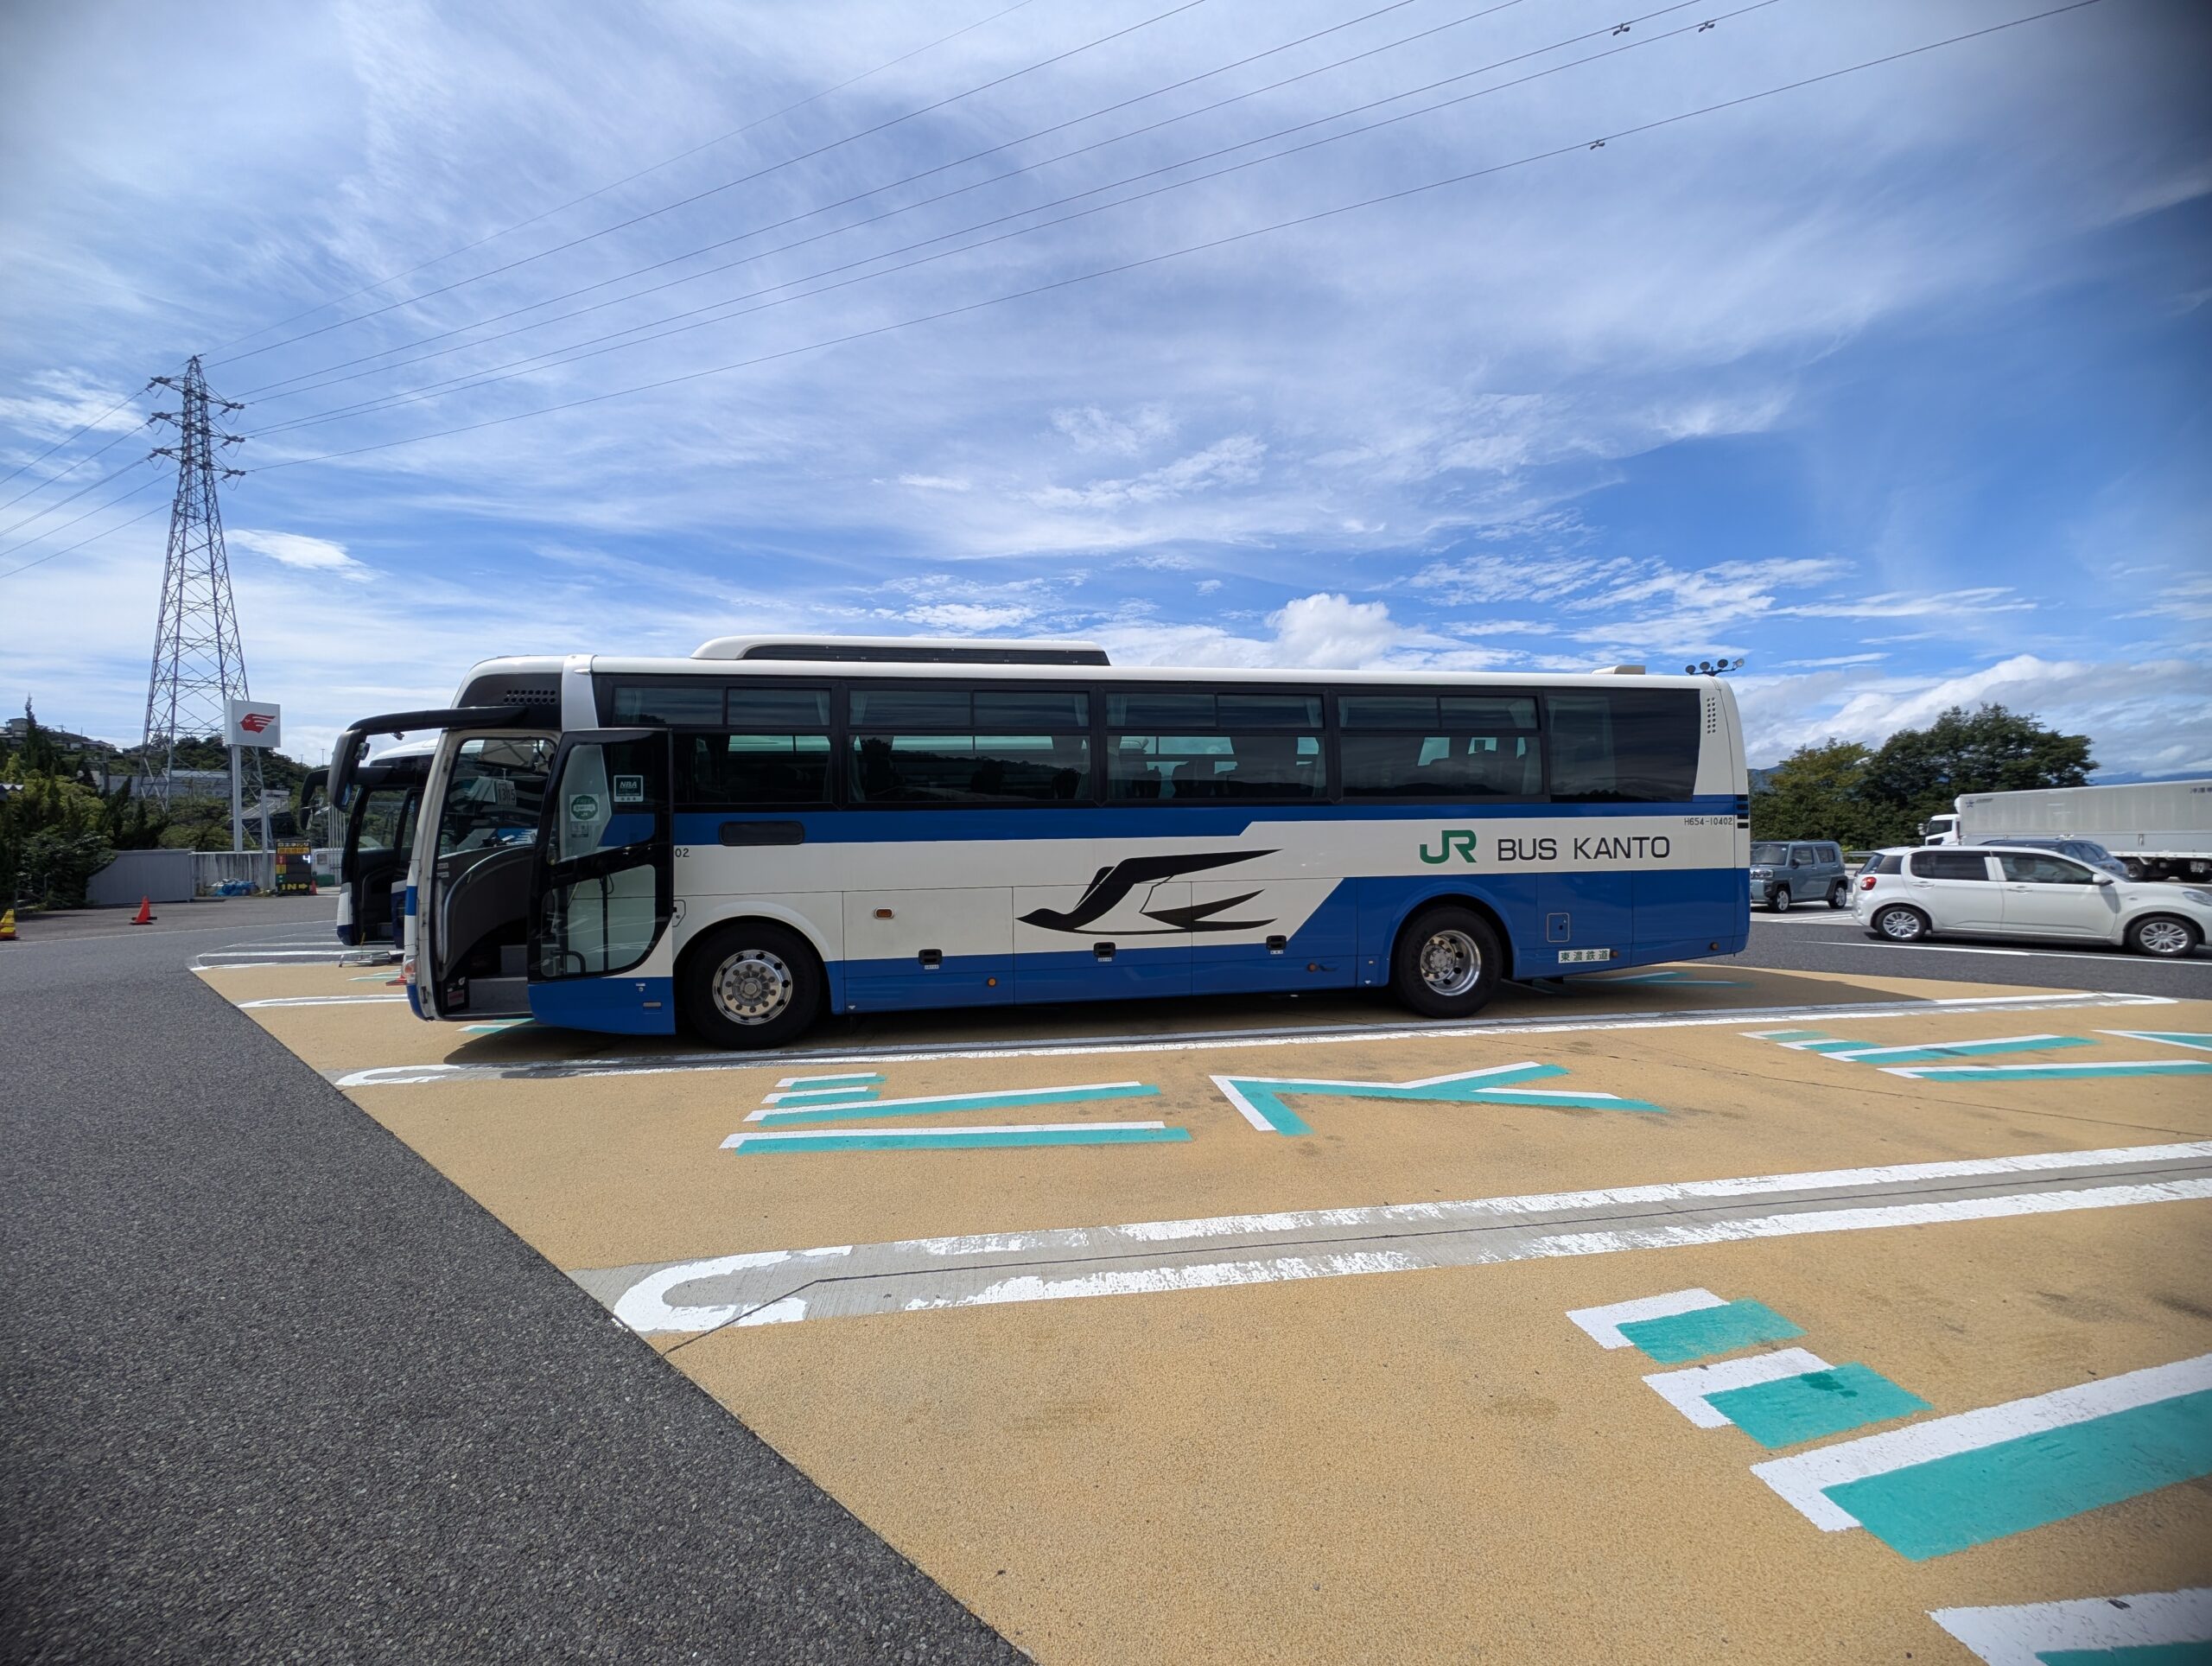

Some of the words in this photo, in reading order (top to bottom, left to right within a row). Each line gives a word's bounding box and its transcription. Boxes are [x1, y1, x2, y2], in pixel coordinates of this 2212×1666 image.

[1684, 817, 1733, 826] H654-10402
[1420, 830, 1477, 864] JR
[1497, 837, 1558, 862] BUS
[1573, 836, 1670, 860] KANTO
[1560, 950, 1609, 962] 東濃鉄道
